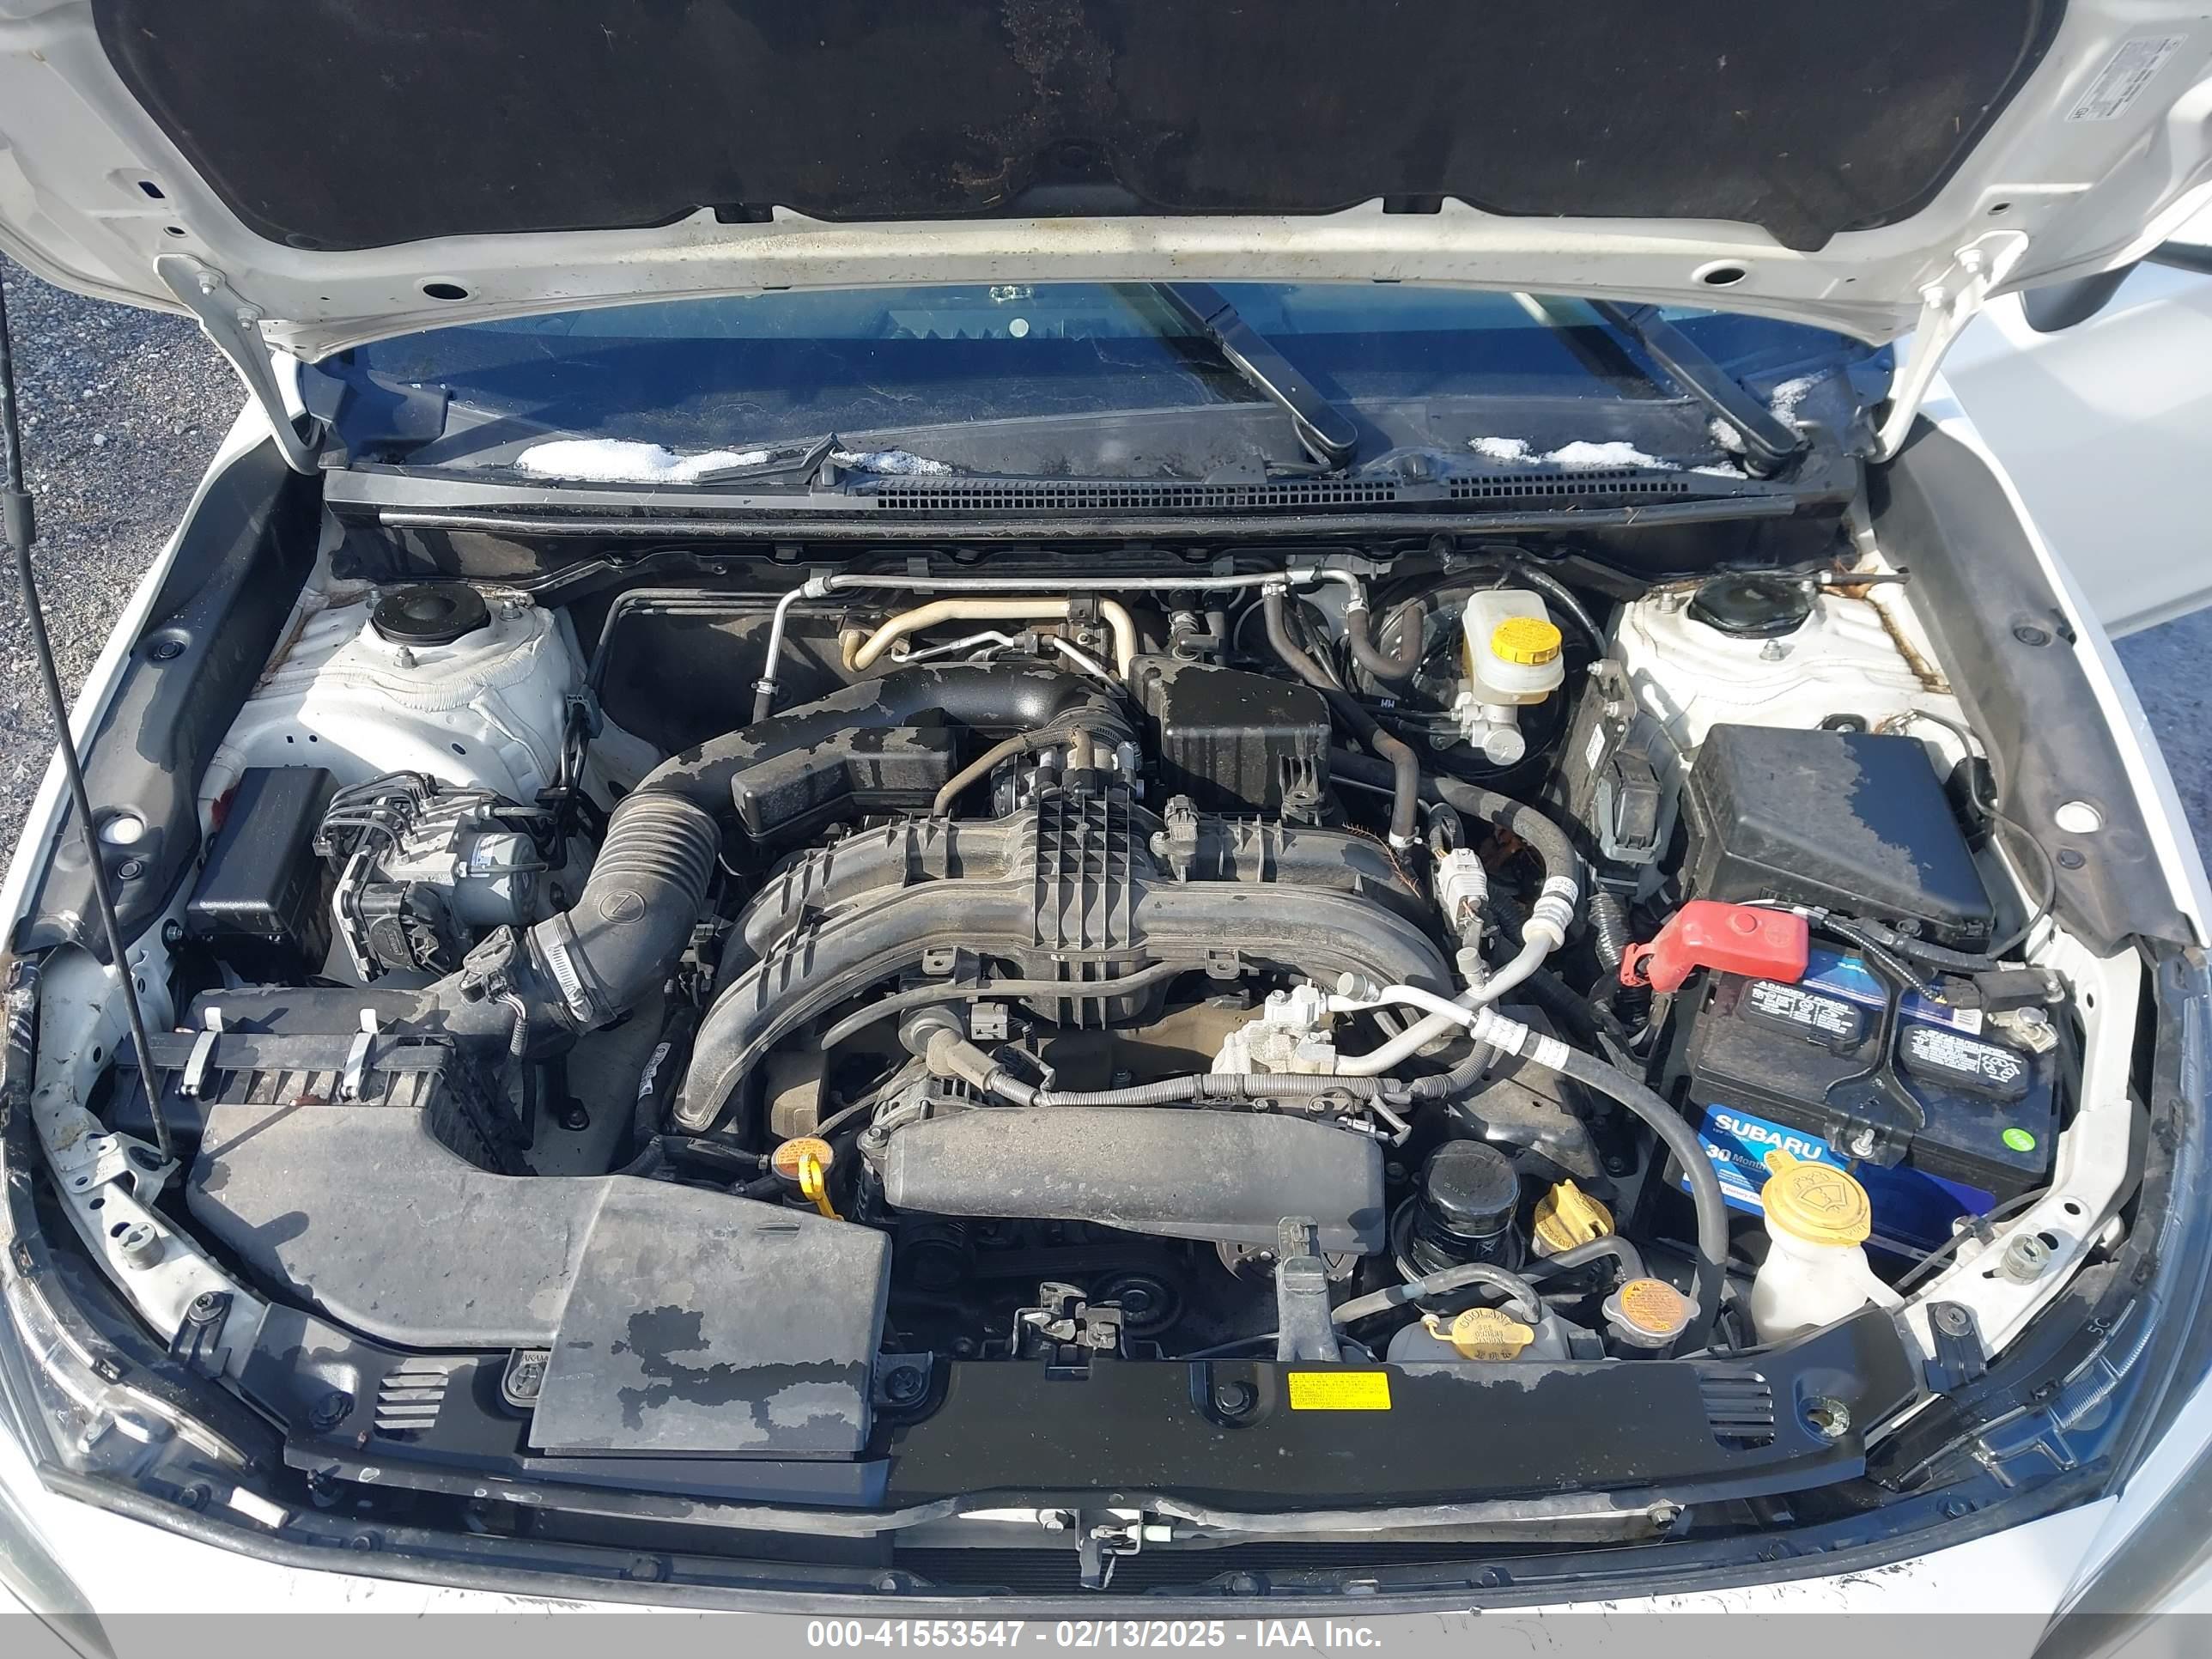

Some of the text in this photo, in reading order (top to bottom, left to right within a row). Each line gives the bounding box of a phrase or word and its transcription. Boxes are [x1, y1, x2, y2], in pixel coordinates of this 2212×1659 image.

[1767, 983, 1806, 999] DANGER
[1814, 995, 1850, 1012] POISON
[1715, 1114, 1823, 1160] SUBARU
[1705, 1144, 1732, 1163] 30
[1459, 1308, 1513, 1329] COOLANT
